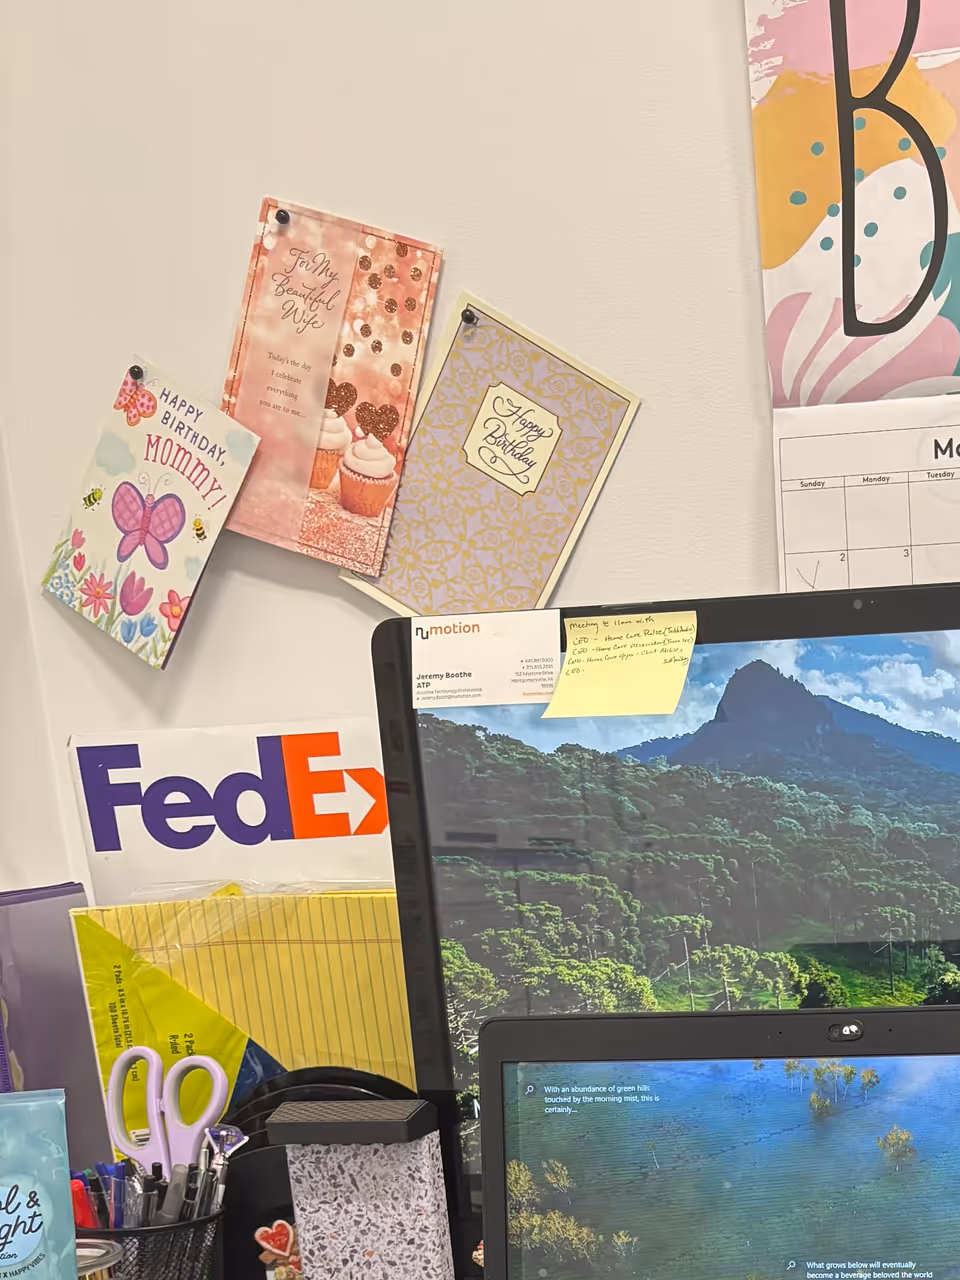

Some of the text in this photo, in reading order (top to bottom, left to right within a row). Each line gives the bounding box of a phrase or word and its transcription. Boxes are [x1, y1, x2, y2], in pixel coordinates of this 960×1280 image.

[284, 247, 340, 289] For My
[271, 272, 341, 312] Beautiful
[281, 299, 325, 334] Wife
[267, 352, 313, 372] Today's the day
[275, 372, 302, 385] celebrate
[266, 385, 299, 402] everything
[159, 387, 204, 424] HAPPY
[259, 399, 282, 412] you are
[492, 396, 554, 442] Happy
[160, 410, 227, 467] BIRTHDAY,
[481, 416, 538, 474] Birthday
[800, 478, 826, 489] Sunday
[862, 474, 891, 484] Monday
[926, 469, 956, 480] Tuesday
[839, 552, 846, 562] 2
[903, 548, 910, 558] 3
[415, 621, 481, 640] numotion
[416, 671, 473, 682] Jeremy Boothe
[416, 681, 432, 690] ATP
[544, 1084, 651, 1095] With an abundance of green hills
[544, 1094, 661, 1105] touched by the morning mist, this is
[9, 1251, 47, 1278] HAPPY VIBES
[806, 1261, 917, 1270] What grows below will eventually
[806, 1270, 934, 1280] become beverage beloved the world
